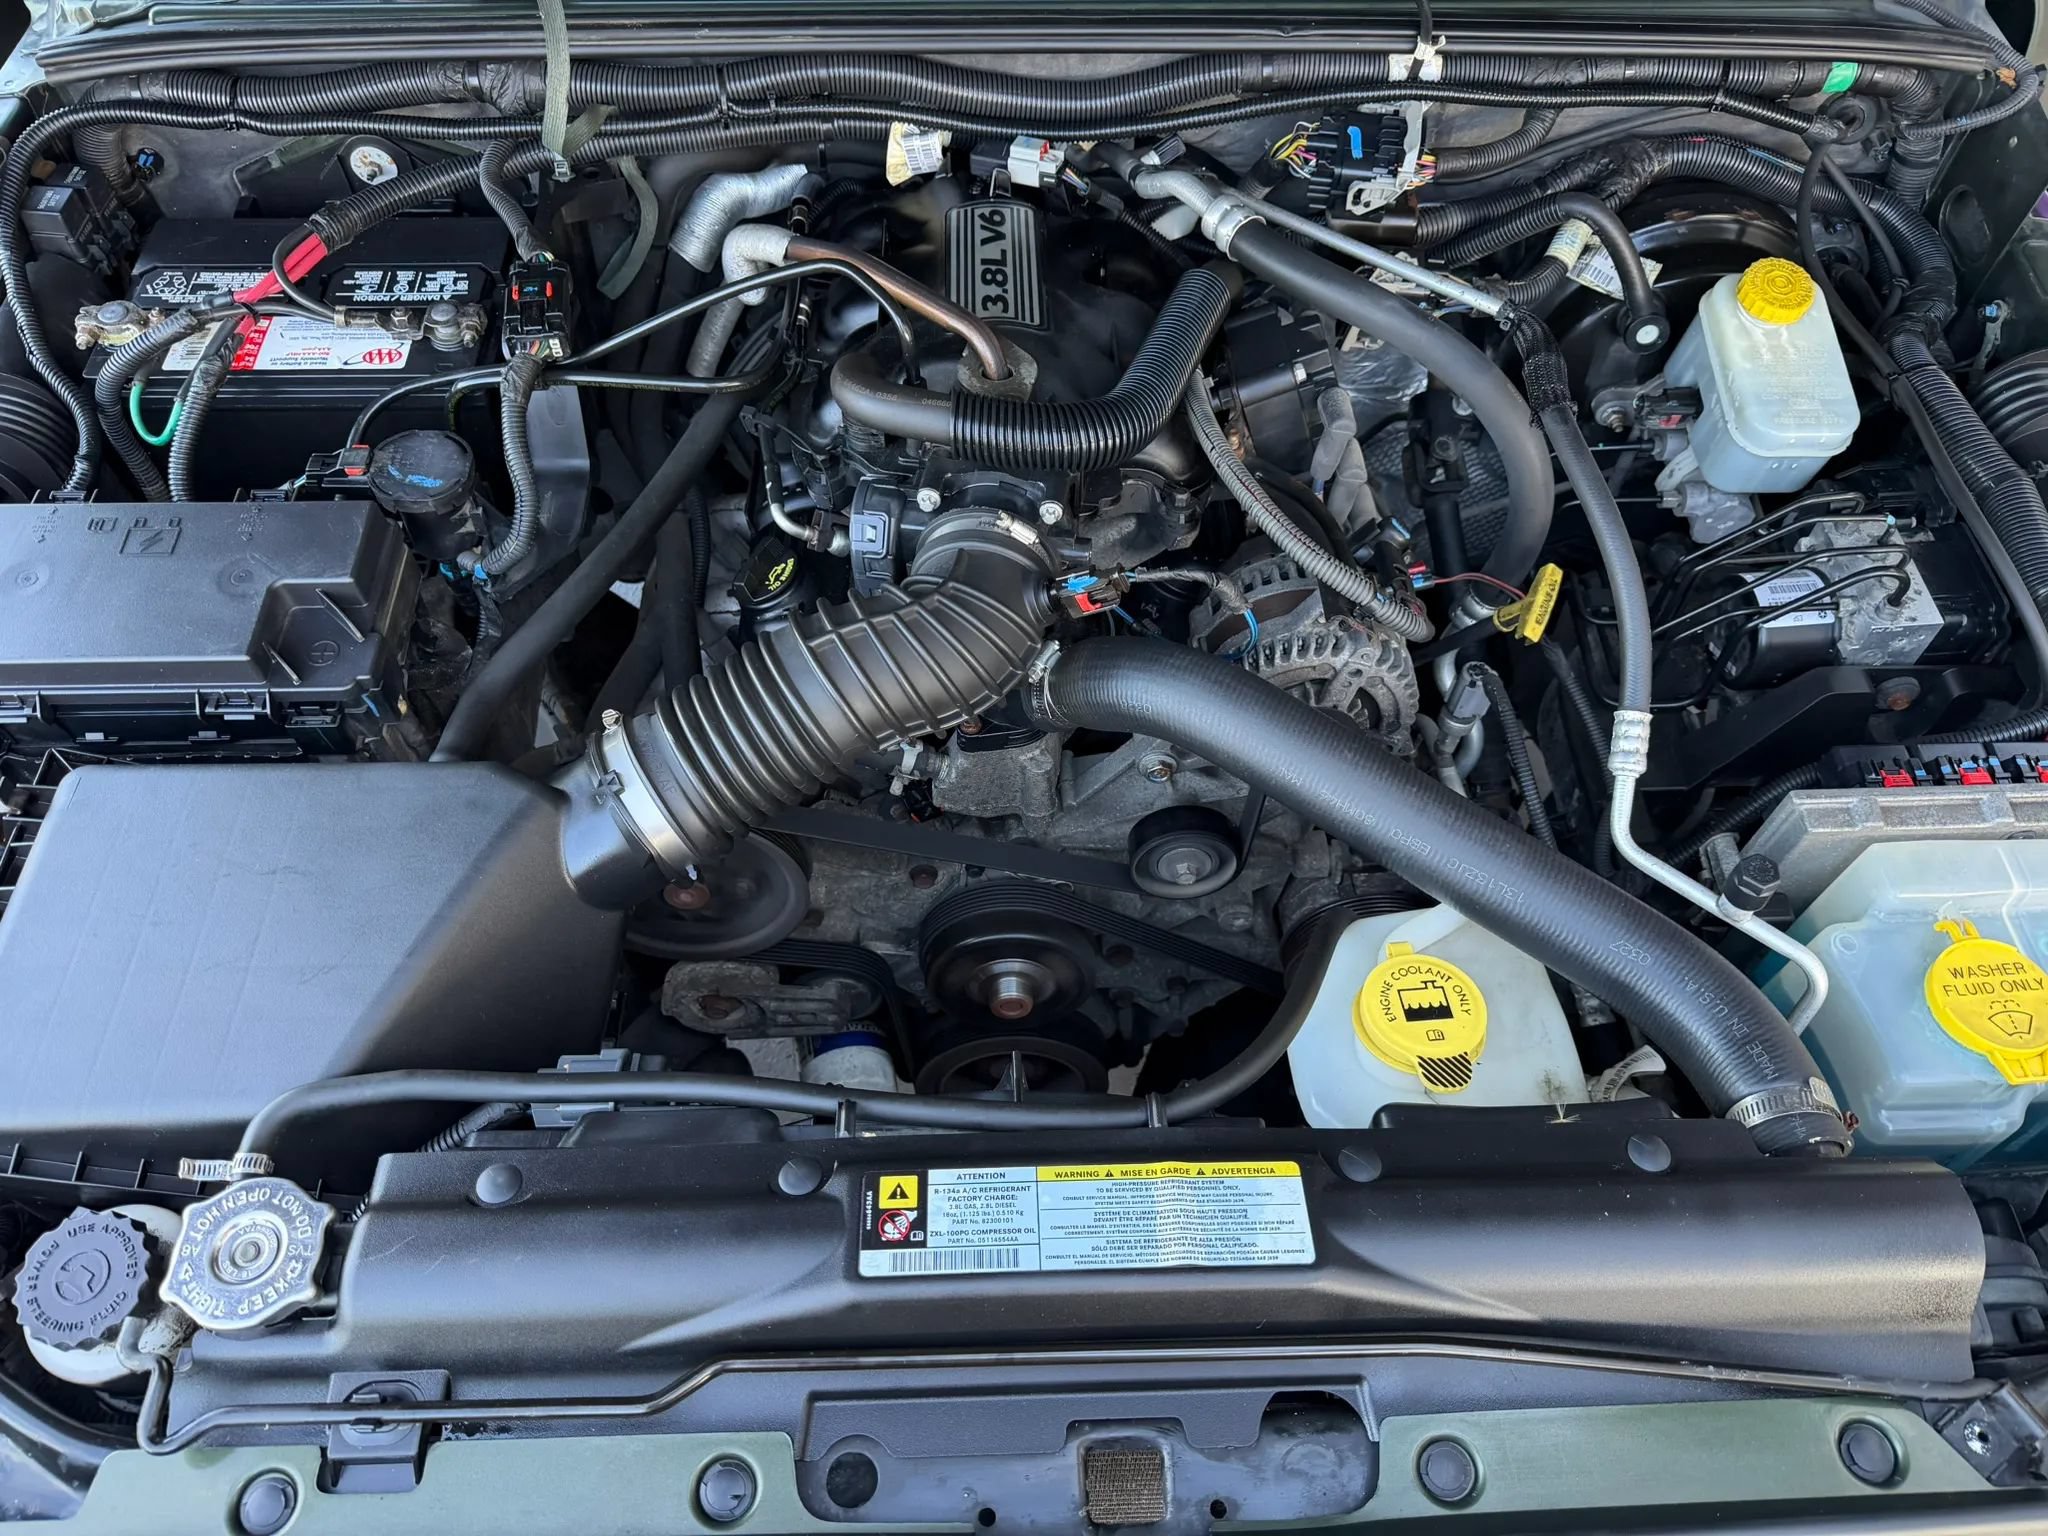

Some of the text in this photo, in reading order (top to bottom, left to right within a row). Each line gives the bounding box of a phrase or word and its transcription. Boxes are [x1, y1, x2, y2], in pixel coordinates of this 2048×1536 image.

[978, 209, 1009, 314] 3.8L V6
[353, 294, 390, 302] POISON
[364, 348, 401, 364] AAA
[768, 581, 781, 591] OIL
[1609, 940, 1651, 966] 0327
[1948, 962, 2027, 980] WASHER
[1380, 966, 1472, 1022] ENGINE COOLANT ONLY
[1943, 978, 2044, 997] FLUID ONLY
[1684, 976, 1779, 1080] MADE IN U.S.A.
[956, 1172, 1006, 1180] ATTENTION
[222, 1187, 270, 1212] OPEN
[272, 1190, 302, 1216] NOT
[190, 1206, 219, 1241] HOT
[67, 1223, 138, 1279] USE APPROVED
[288, 1244, 314, 1256] TVS
[182, 1278, 288, 1316] KEEP TIGHT
